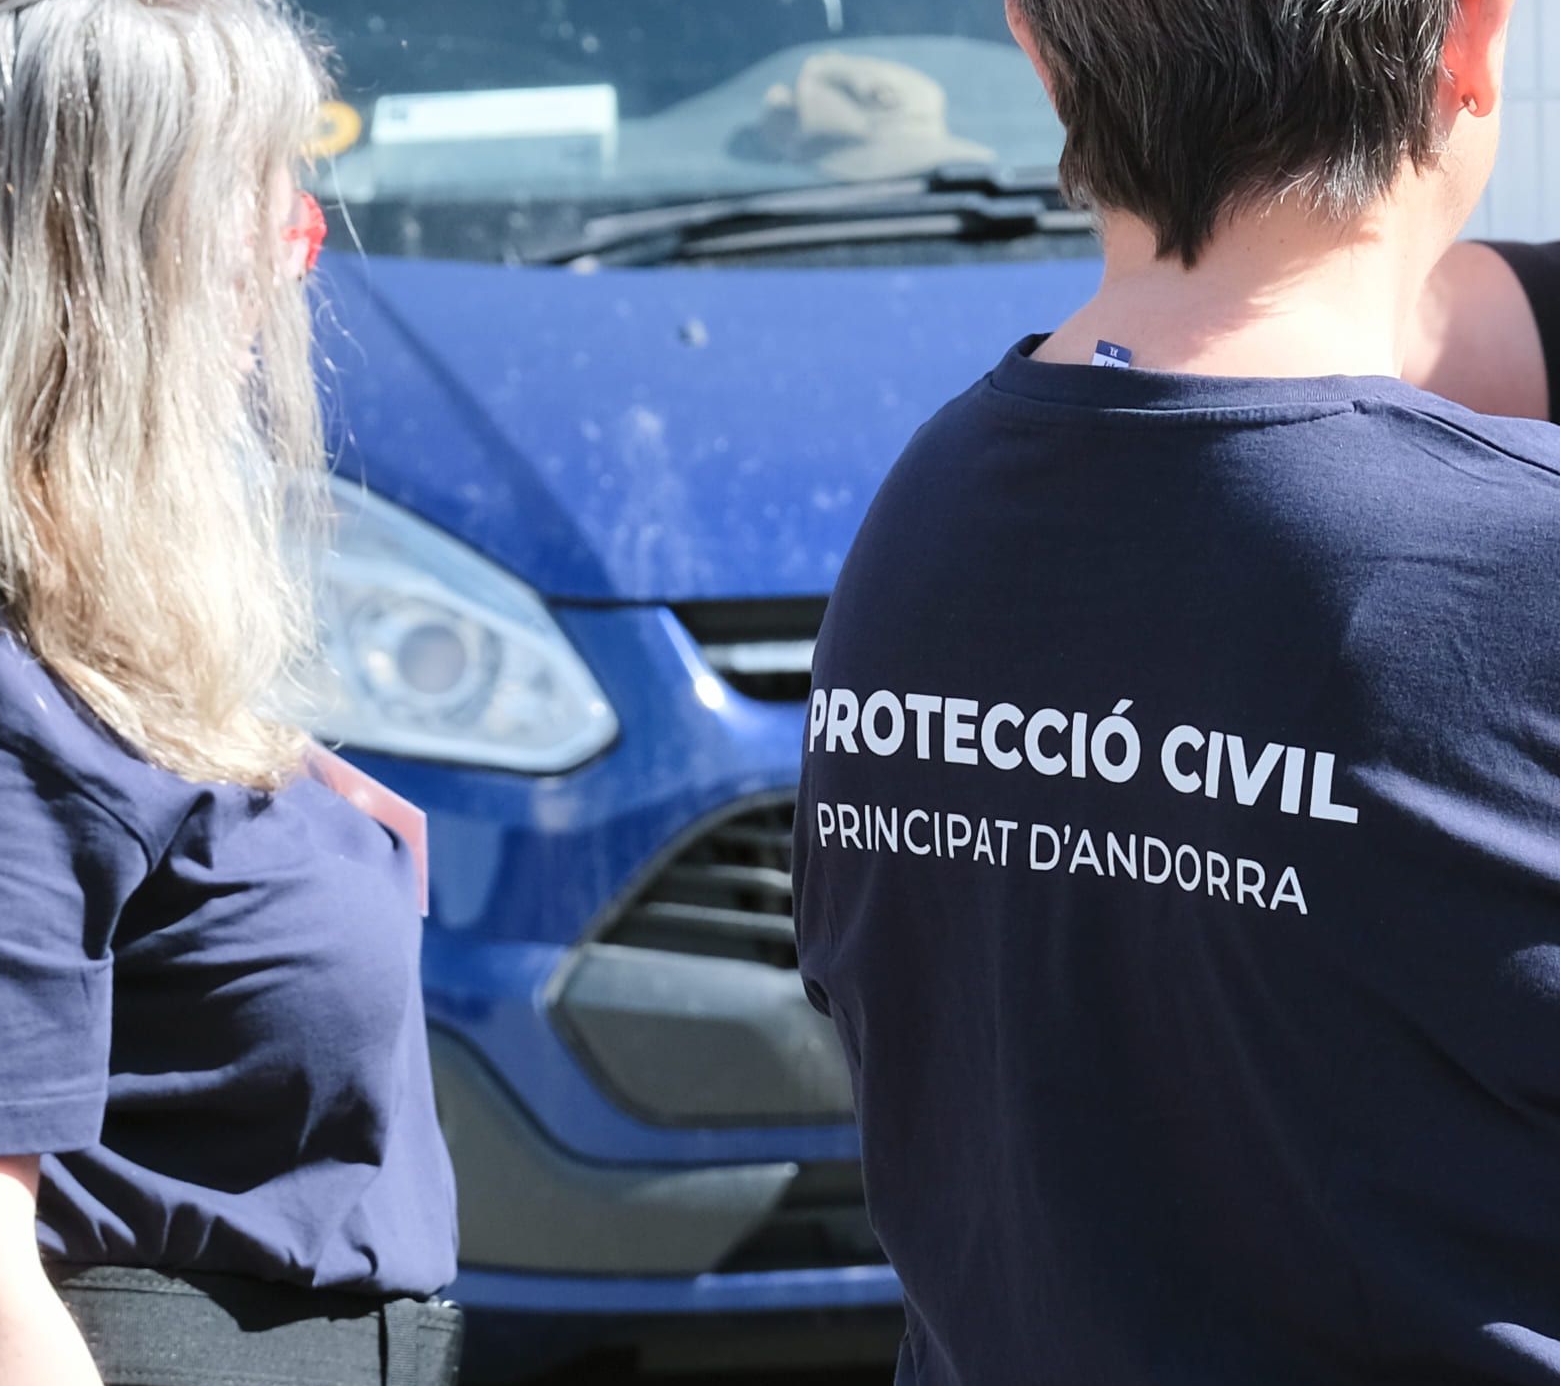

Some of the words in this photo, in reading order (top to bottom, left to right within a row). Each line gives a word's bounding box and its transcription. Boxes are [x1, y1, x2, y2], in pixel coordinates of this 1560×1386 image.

[809, 688, 1141, 784] PROTECCIÓ
[1160, 724, 1359, 824] CIVIL
[817, 802, 1018, 866] PRINCIPAT
[1029, 823, 1309, 915] D'ANDORRA
